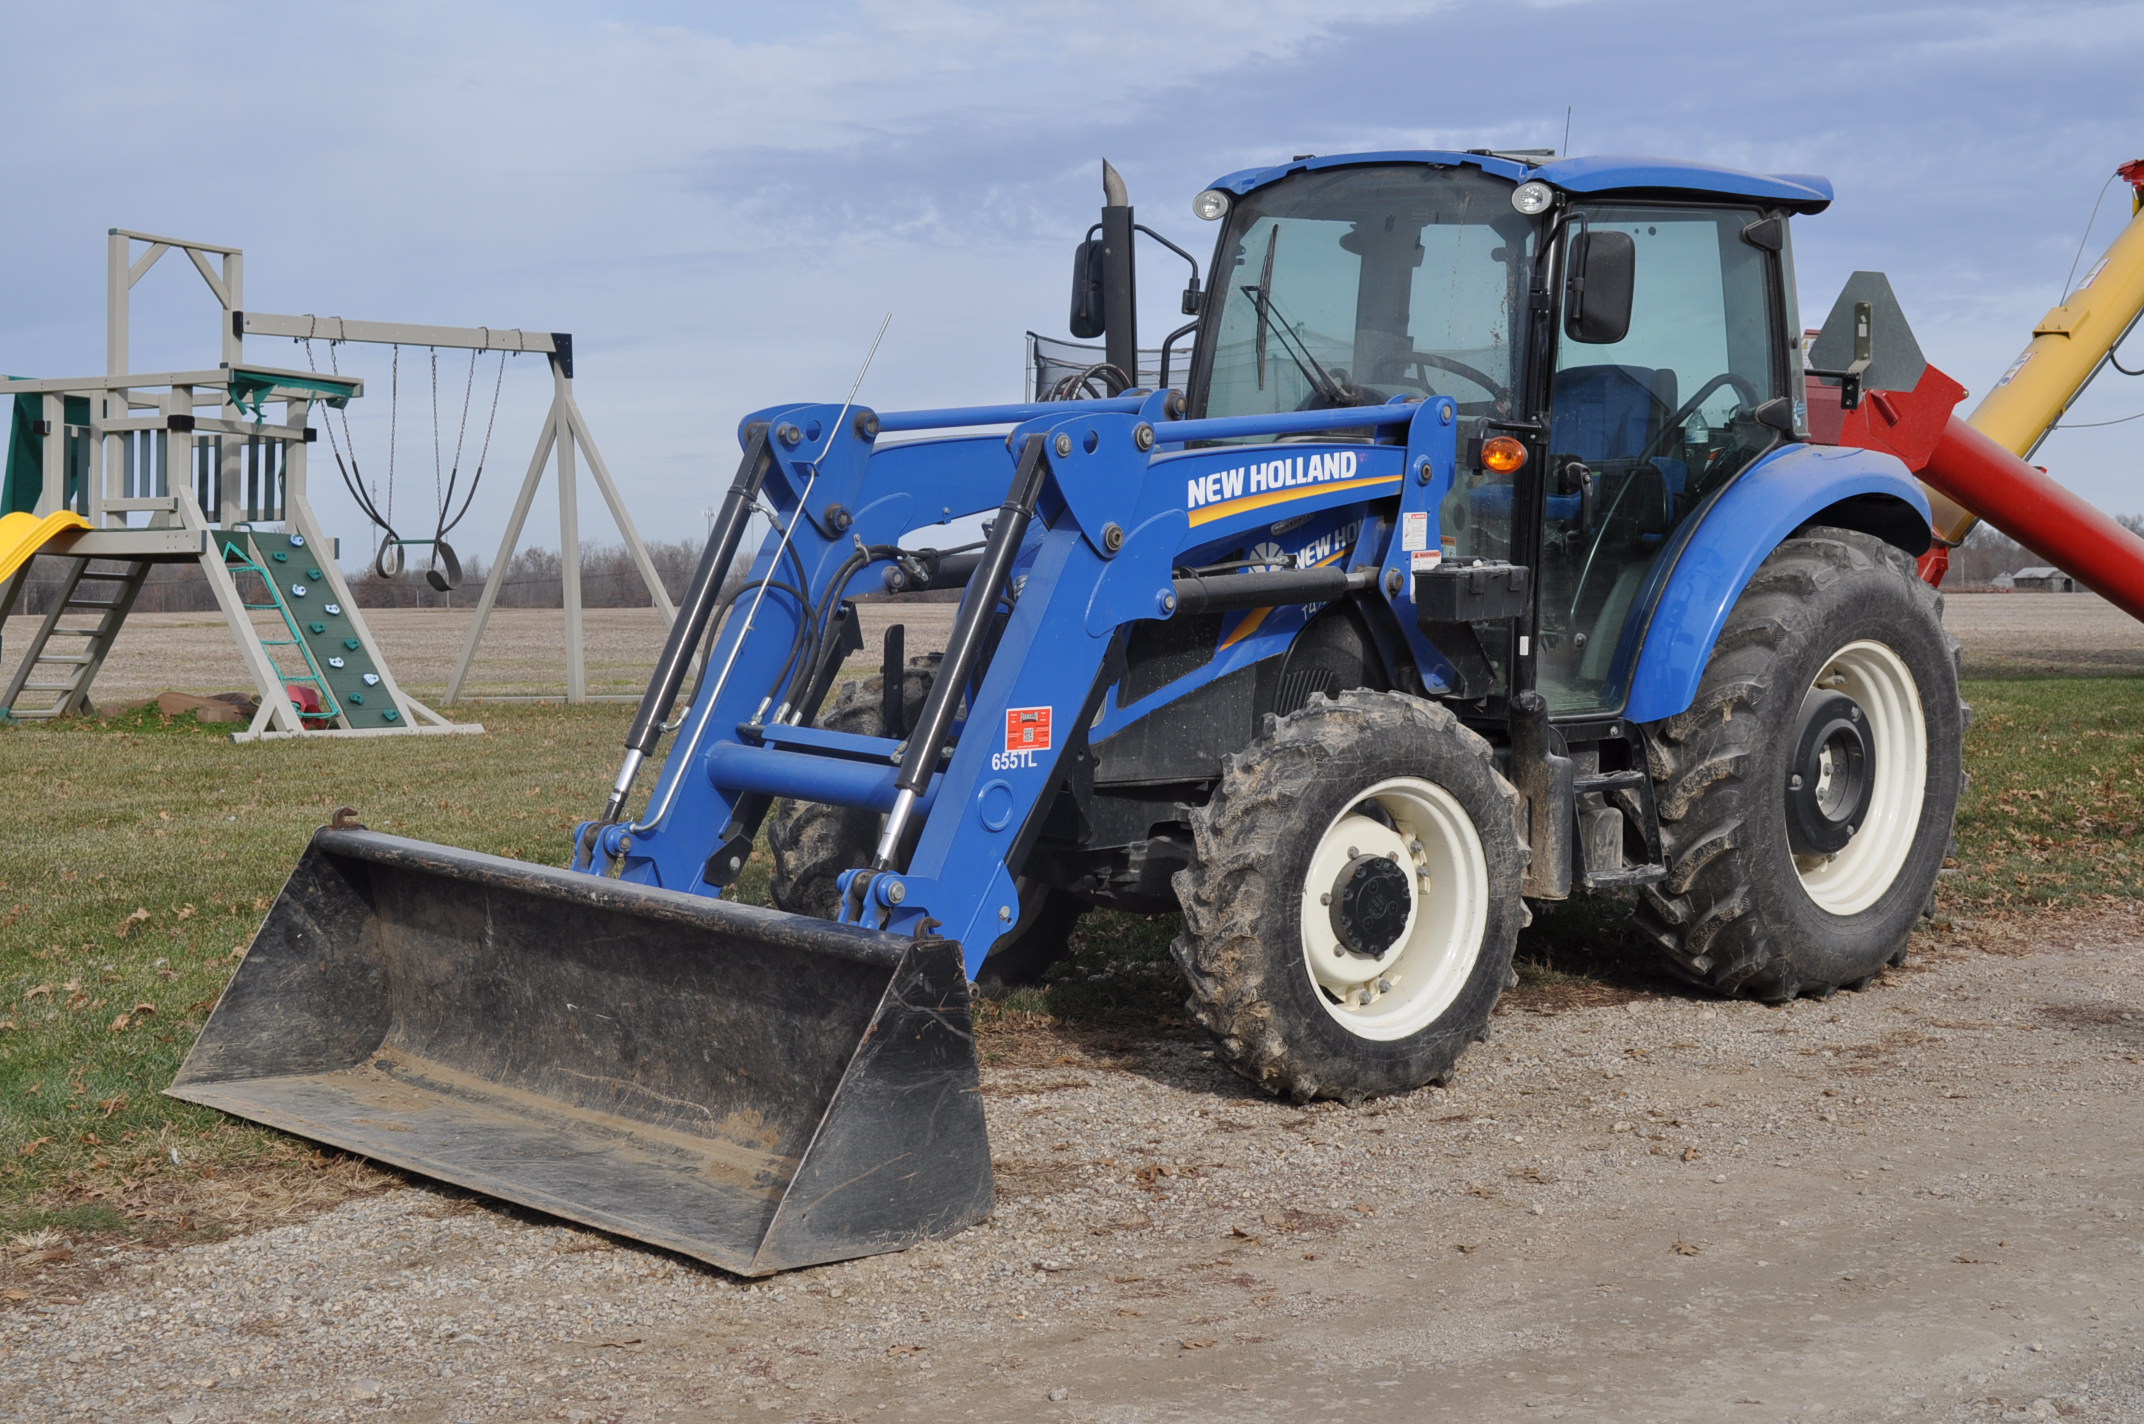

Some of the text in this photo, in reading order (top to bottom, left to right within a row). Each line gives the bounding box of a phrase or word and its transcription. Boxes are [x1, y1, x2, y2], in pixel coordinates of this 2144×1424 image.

[1188, 451, 1357, 508] NEW HOLLAND
[1295, 533, 1332, 569] NEW
[991, 751, 1037, 771] 655TL
